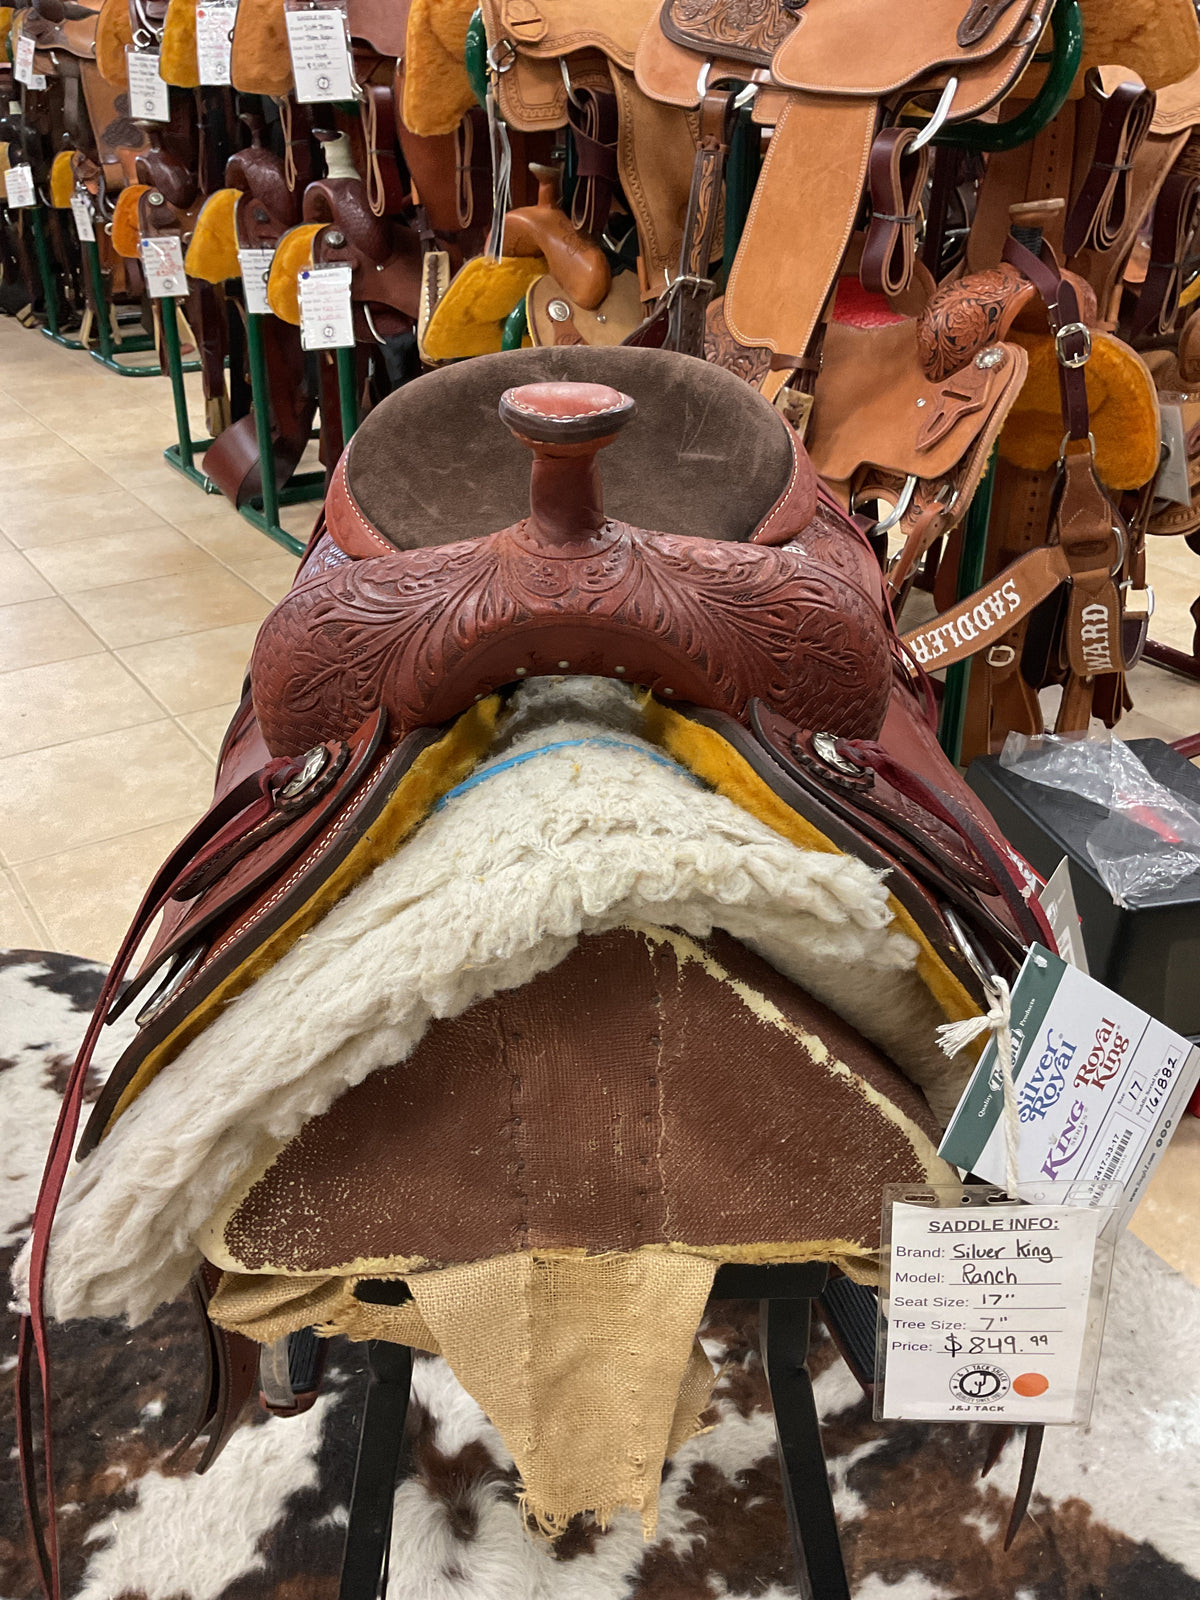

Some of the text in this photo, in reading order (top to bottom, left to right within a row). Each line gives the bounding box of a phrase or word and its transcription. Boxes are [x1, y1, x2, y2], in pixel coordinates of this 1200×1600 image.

[1080, 603, 1113, 672] WARD
[978, 1093, 993, 1118] Quality
[1019, 998, 1036, 1027] Products
[1017, 1028, 1058, 1123] Silver
[1029, 1040, 1077, 1121] Royal
[1073, 1017, 1116, 1088] Royal
[1091, 1031, 1129, 1092] King
[1128, 1080, 1143, 1101] 17
[1145, 1057, 1178, 1114] 161882
[1040, 1100, 1088, 1181] KING
[896, 1245, 946, 1258] Brand:
[952, 1243, 1006, 1260] Silver
[928, 1217, 1060, 1233] SADDLE INFO:
[894, 1296, 928, 1308] Seat
[932, 1296, 970, 1308] Size:
[895, 1263, 1018, 1285] Model: Ranch
[892, 1341, 932, 1352] Price:
[893, 1319, 926, 1330] Tree
[930, 1320, 967, 1331] Size:
